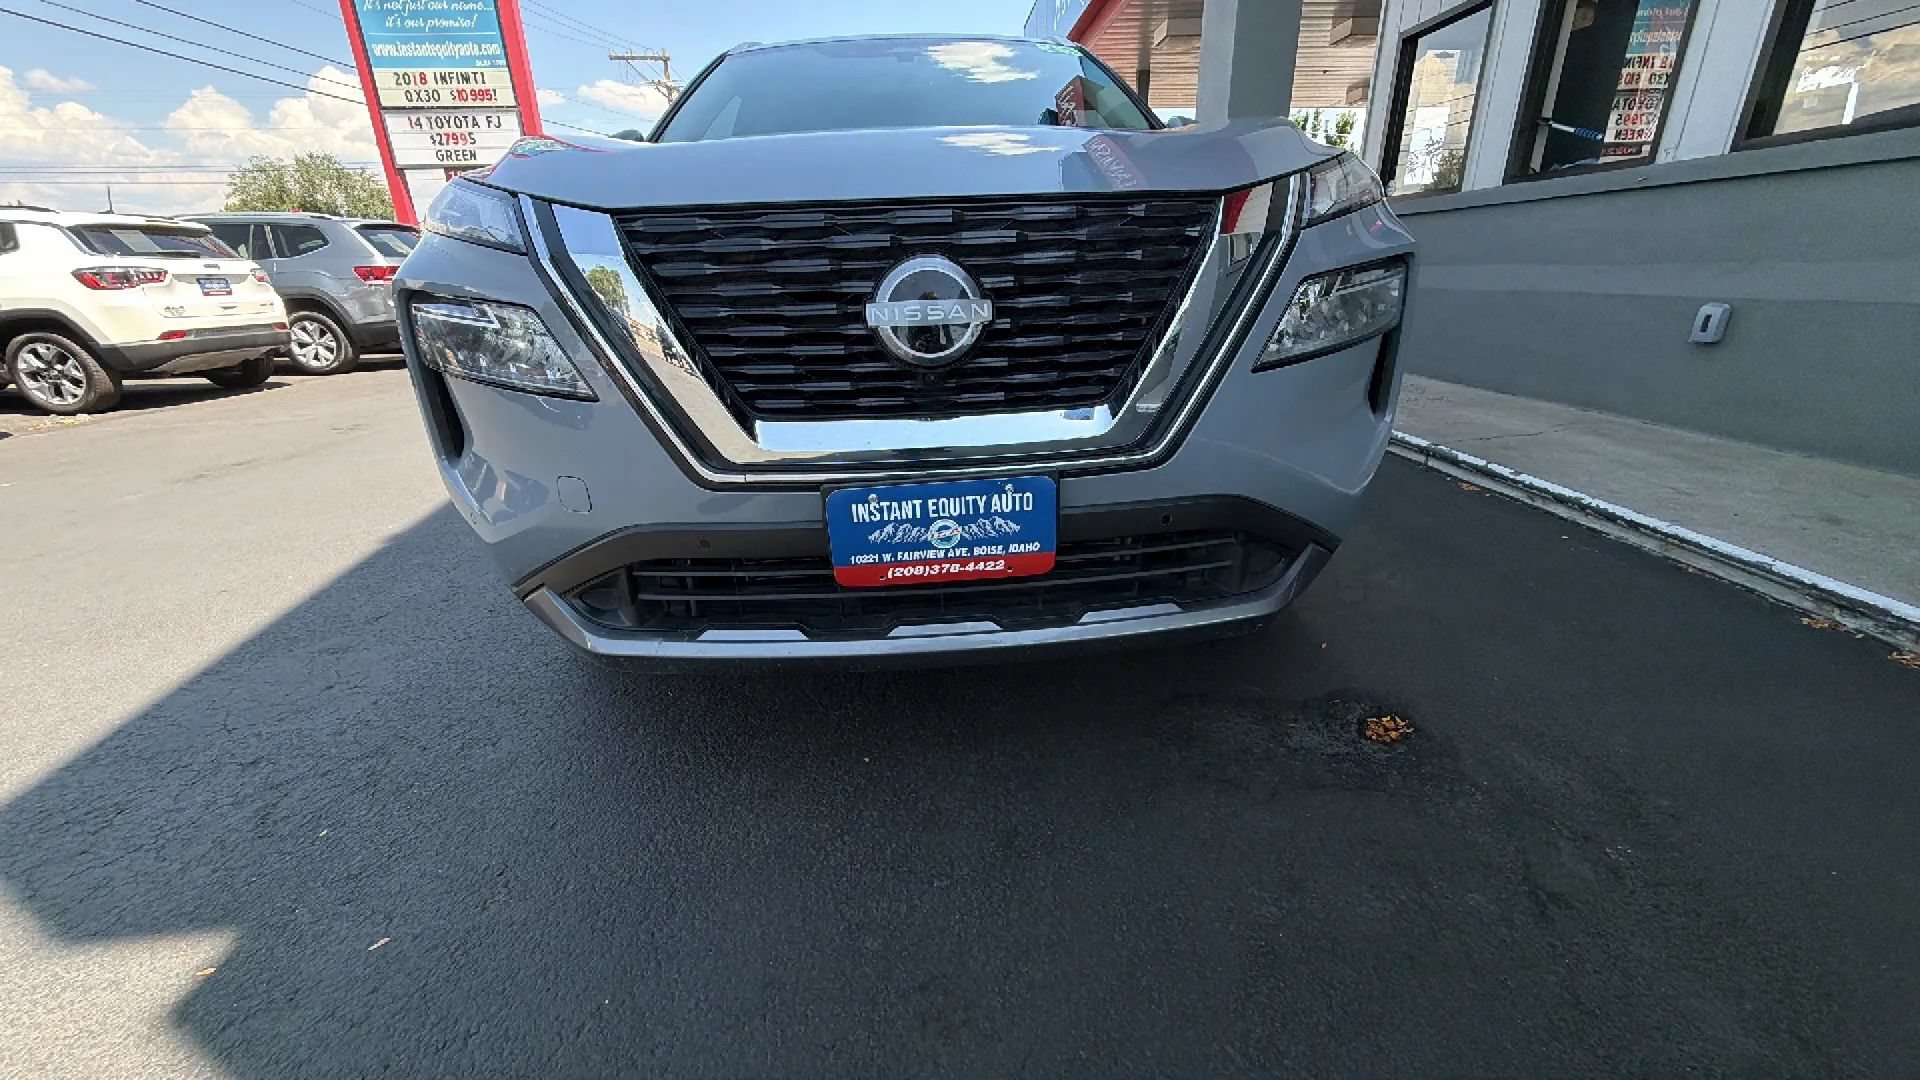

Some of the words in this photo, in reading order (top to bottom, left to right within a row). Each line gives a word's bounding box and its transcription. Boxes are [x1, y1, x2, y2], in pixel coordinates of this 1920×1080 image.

[427, 0, 449, 10] our
[385, 14, 401, 27] it's
[404, 17, 424, 28] our
[425, 14, 477, 32] promise!
[372, 40, 501, 60] www.instantequityauto.com
[393, 71, 428, 86] 2018
[407, 116, 423, 130] 14
[426, 115, 481, 130] TOYOTA
[485, 115, 502, 129] FJ
[430, 132, 477, 146] $27995
[435, 149, 477, 162] GREEN
[870, 303, 988, 322] NISSAN
[851, 498, 923, 523] INSTANT
[928, 494, 987, 518] EQUITY
[990, 491, 1033, 513] AUTO
[849, 553, 879, 565] 10221
[881, 552, 895, 563] W.
[897, 549, 945, 562] FAIRVIEW
[947, 548, 971, 558] AVE.
[973, 544, 1006, 557] BOISE,
[1008, 541, 1041, 554] IDAHO
[887, 559, 1006, 580] (208)378-4422
